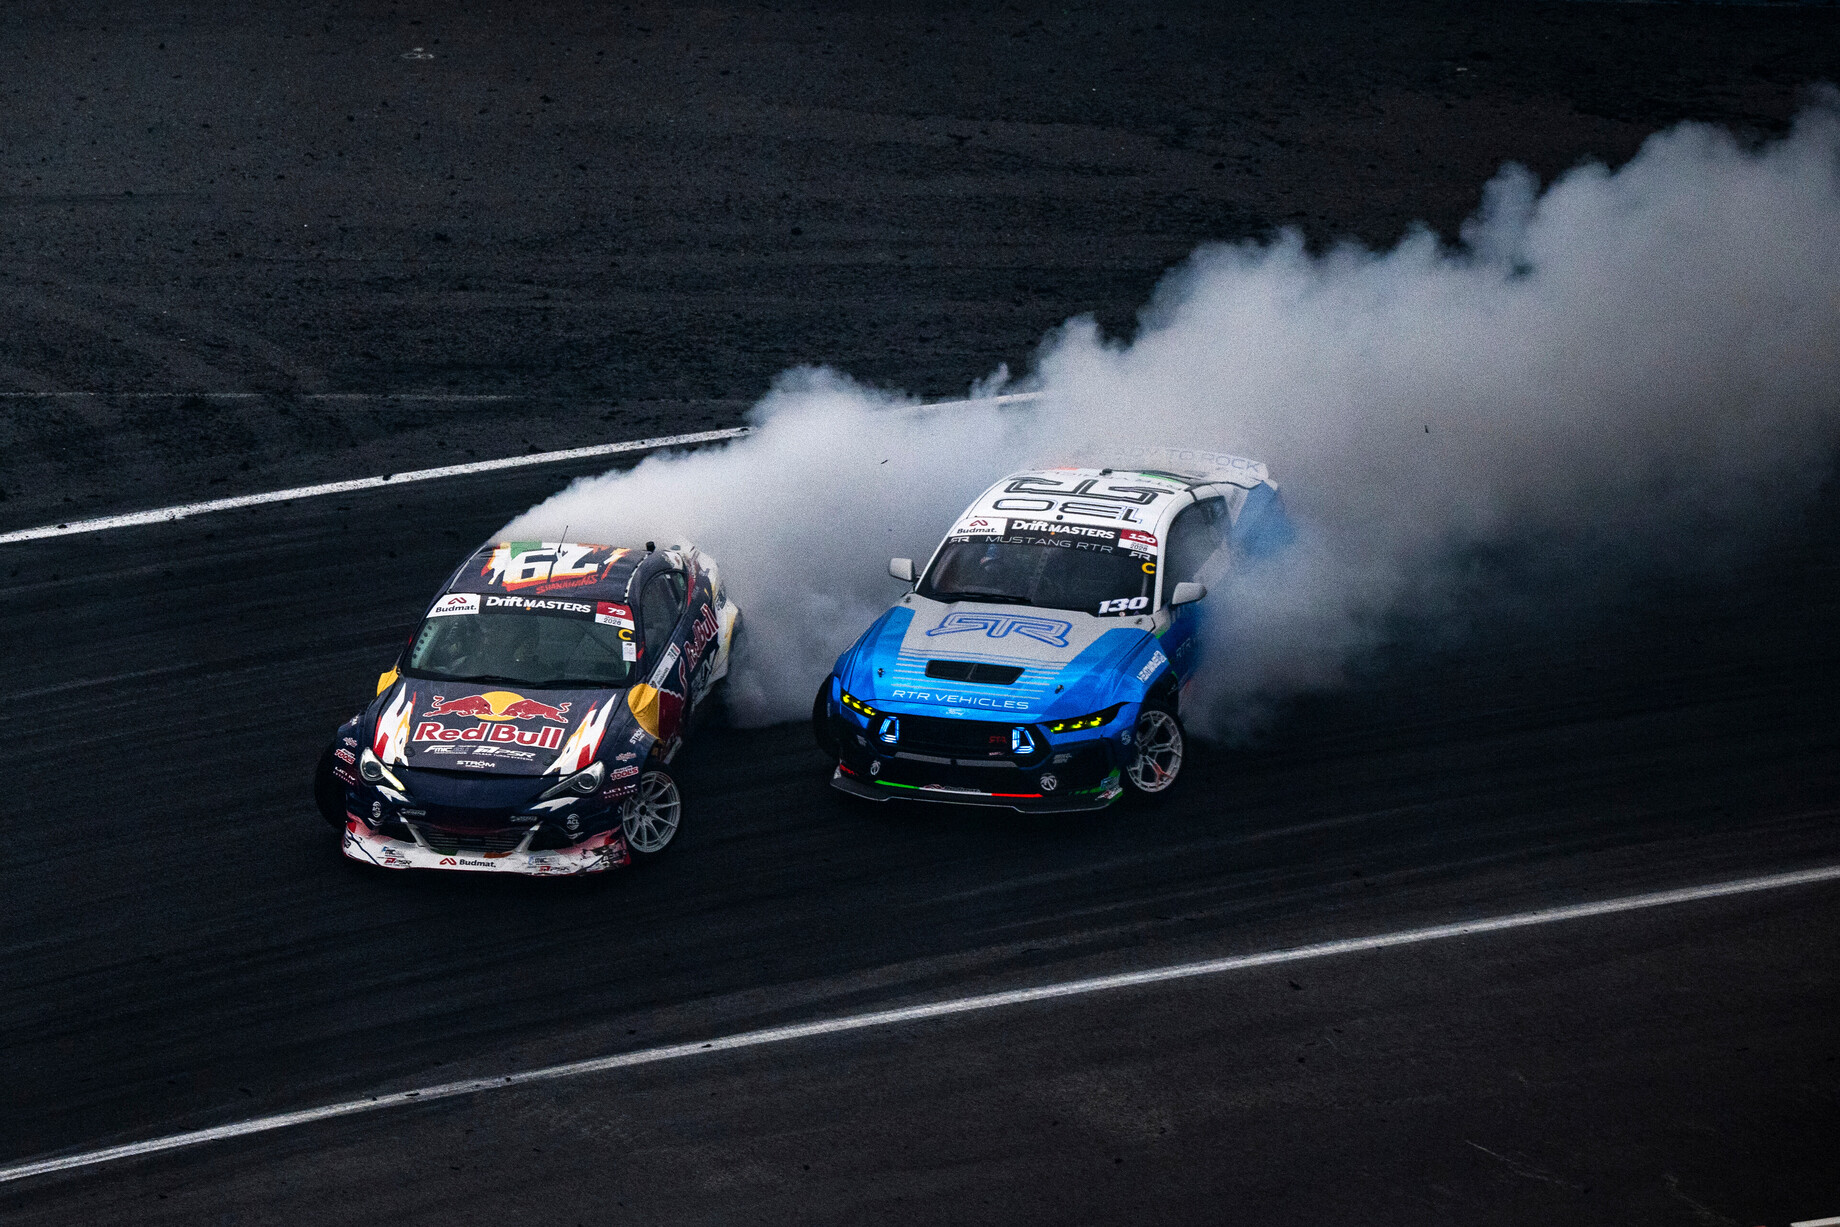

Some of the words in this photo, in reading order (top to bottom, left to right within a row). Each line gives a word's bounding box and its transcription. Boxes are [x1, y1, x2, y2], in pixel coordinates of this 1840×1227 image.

[985, 535, 1071, 548] MUSTANG
[1076, 541, 1113, 554] RTR
[1129, 533, 1156, 544] 130
[1141, 562, 1156, 574] C
[436, 604, 477, 613] Budmat.
[607, 607, 627, 616] 79
[1098, 596, 1149, 614] 130
[618, 629, 633, 641] C
[892, 689, 930, 700] RTR
[935, 693, 1029, 710] VEHICLES
[412, 721, 491, 742] Red
[487, 723, 565, 750] Bull
[459, 859, 497, 868] Budmat.
